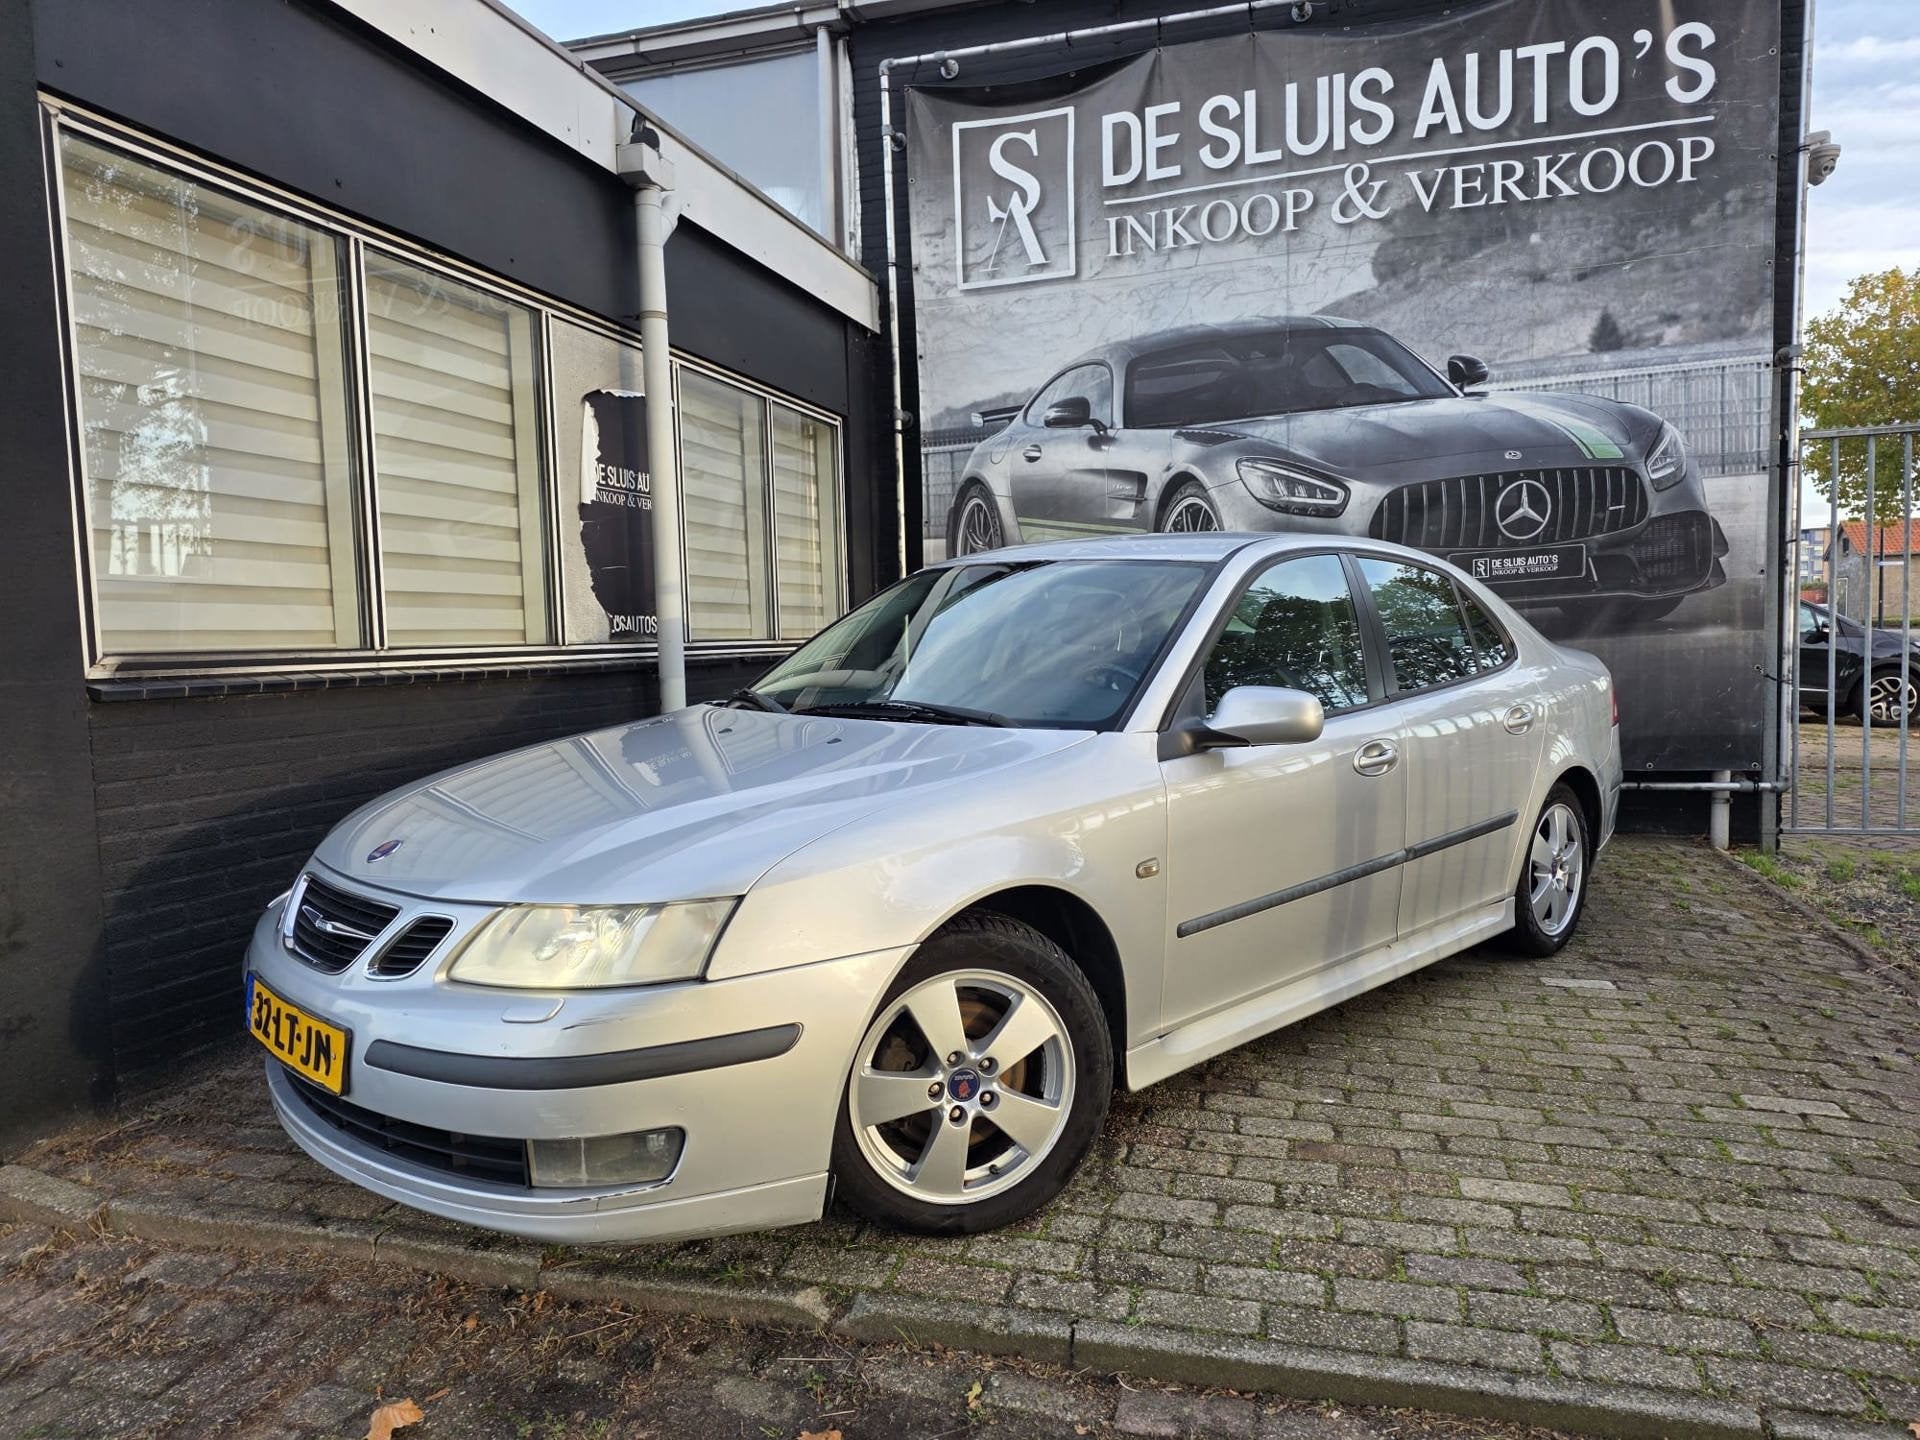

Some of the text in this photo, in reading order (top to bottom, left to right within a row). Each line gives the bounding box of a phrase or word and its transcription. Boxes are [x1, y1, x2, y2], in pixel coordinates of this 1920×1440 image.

[1102, 22, 1716, 187] DE SLUIS AUTO'S
[1105, 136, 1716, 257] INKOOP & VERKOOP
[607, 465, 636, 490] SLUIS
[1491, 559, 1502, 568] DE
[1503, 557, 1526, 567] SLUIS
[1492, 568, 1518, 576] INKOOP
[1526, 565, 1559, 573] VERKOOP
